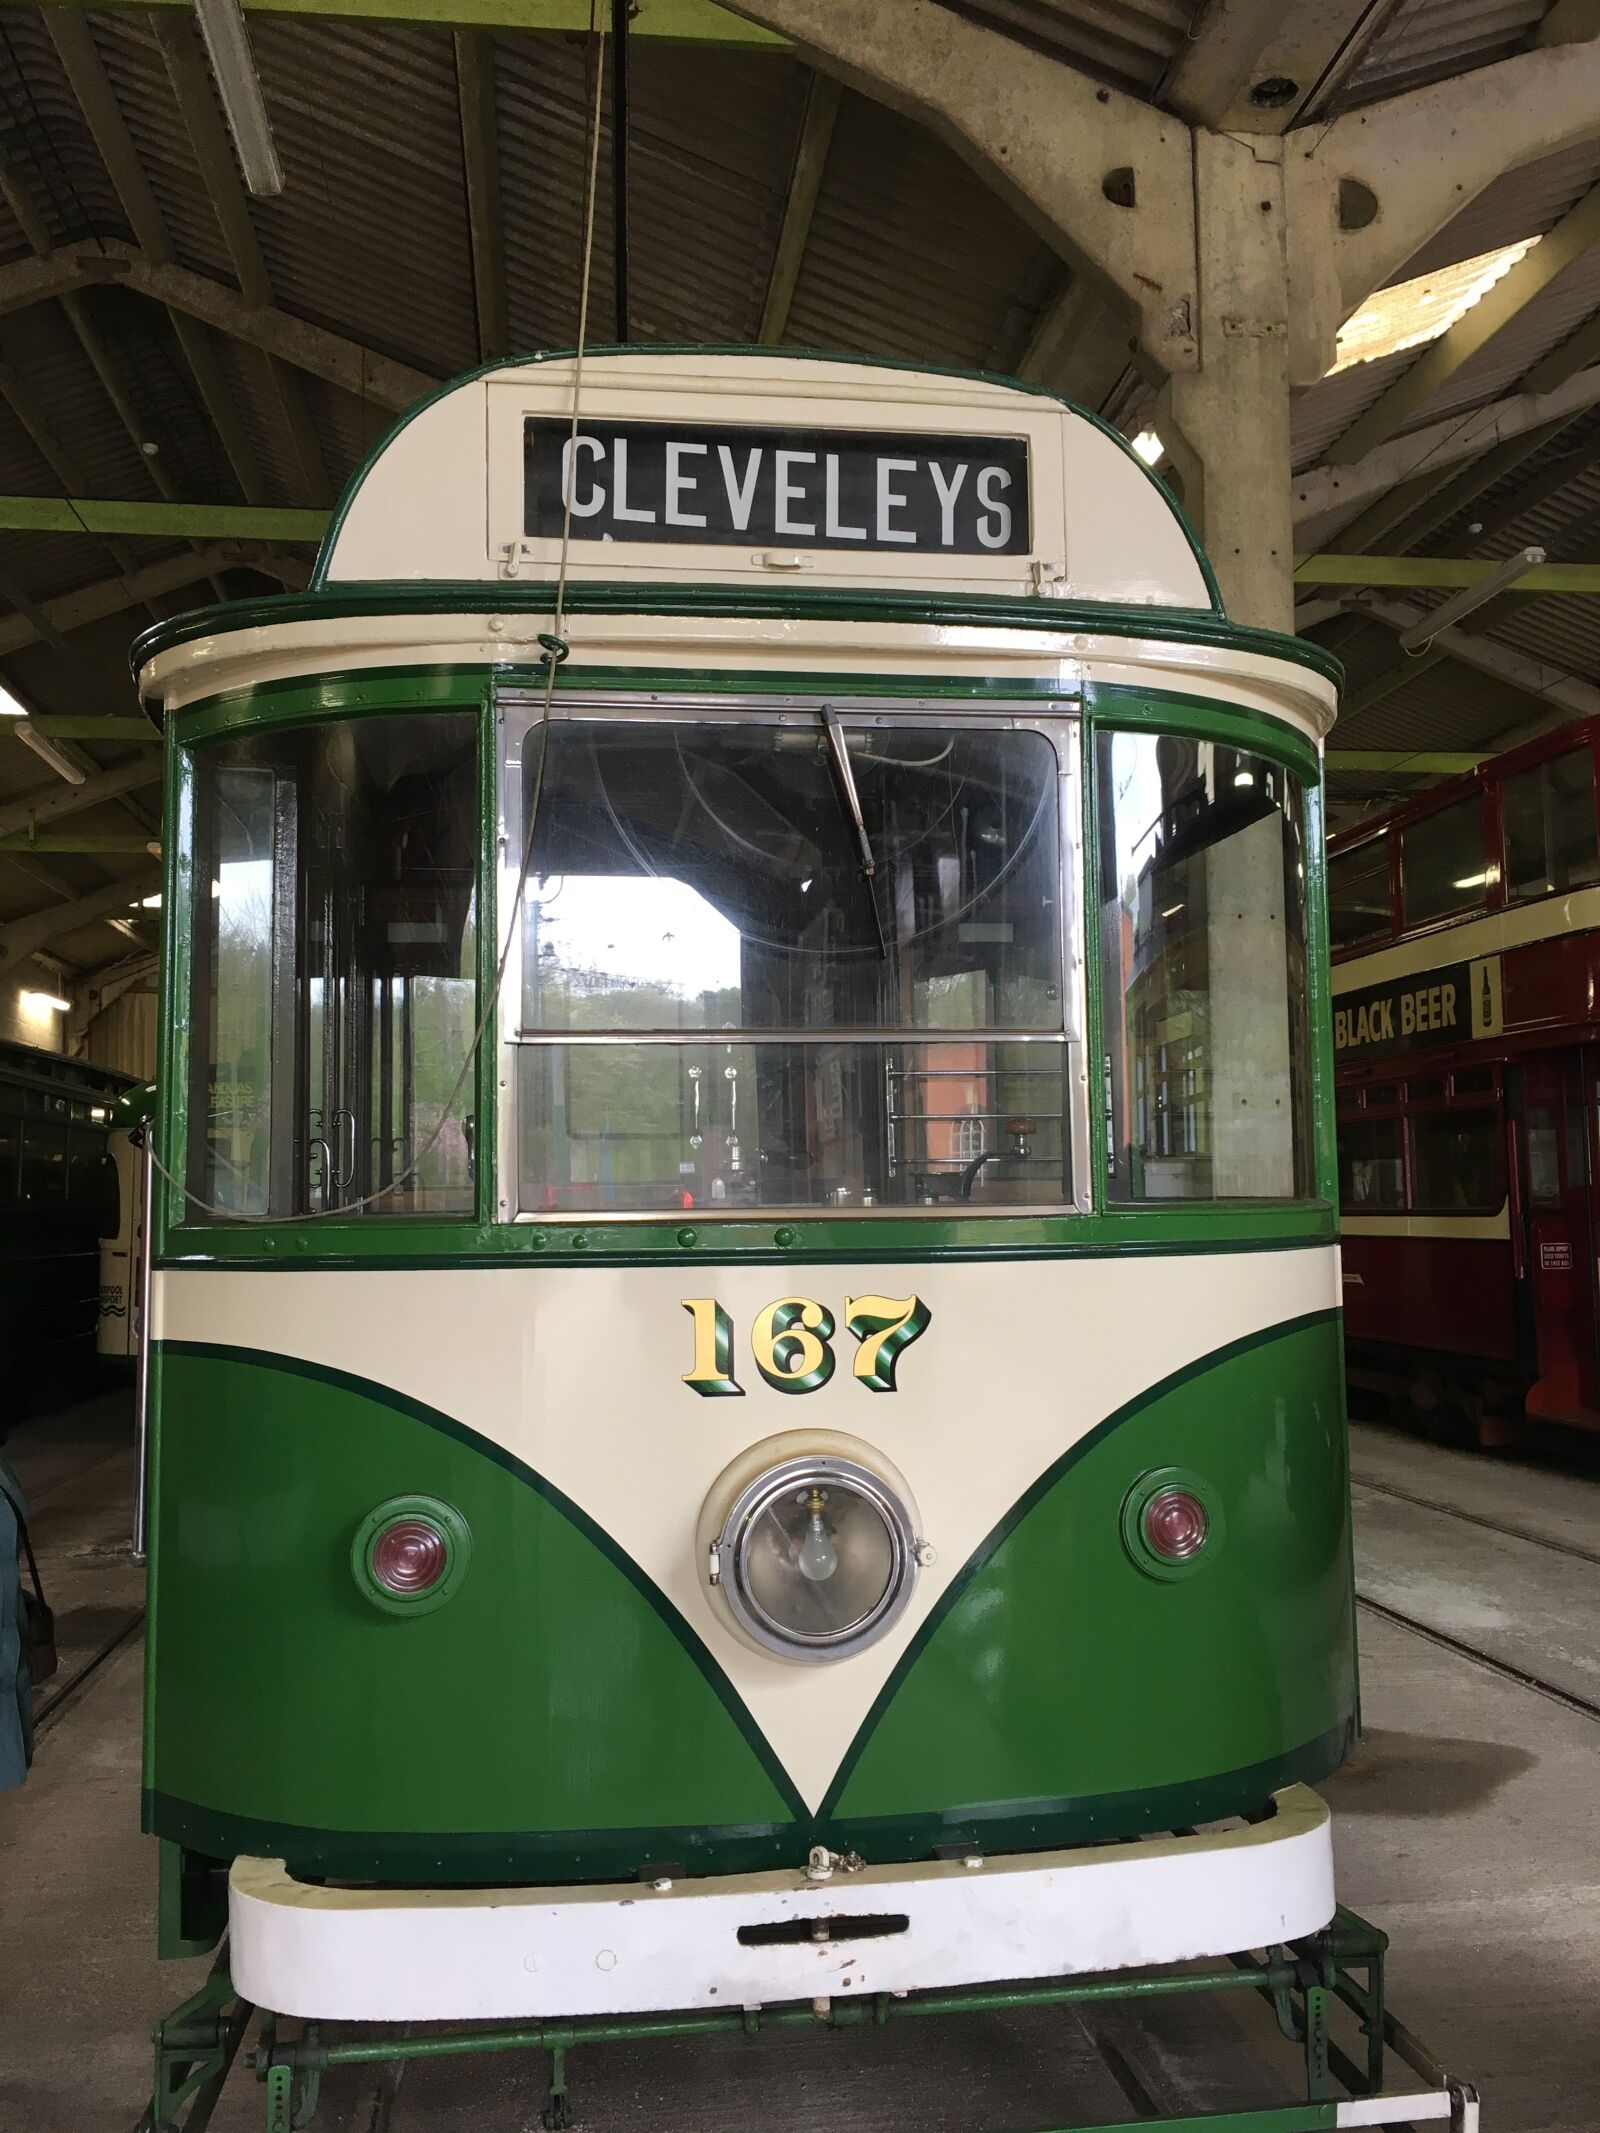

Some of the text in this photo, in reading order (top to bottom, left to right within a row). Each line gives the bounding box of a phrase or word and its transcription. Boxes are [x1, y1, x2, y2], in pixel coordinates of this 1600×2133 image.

[561, 435, 1012, 549] CLEVELEYS
[1334, 983, 1456, 1049] BLACK BEER
[681, 1294, 932, 1397] 167
